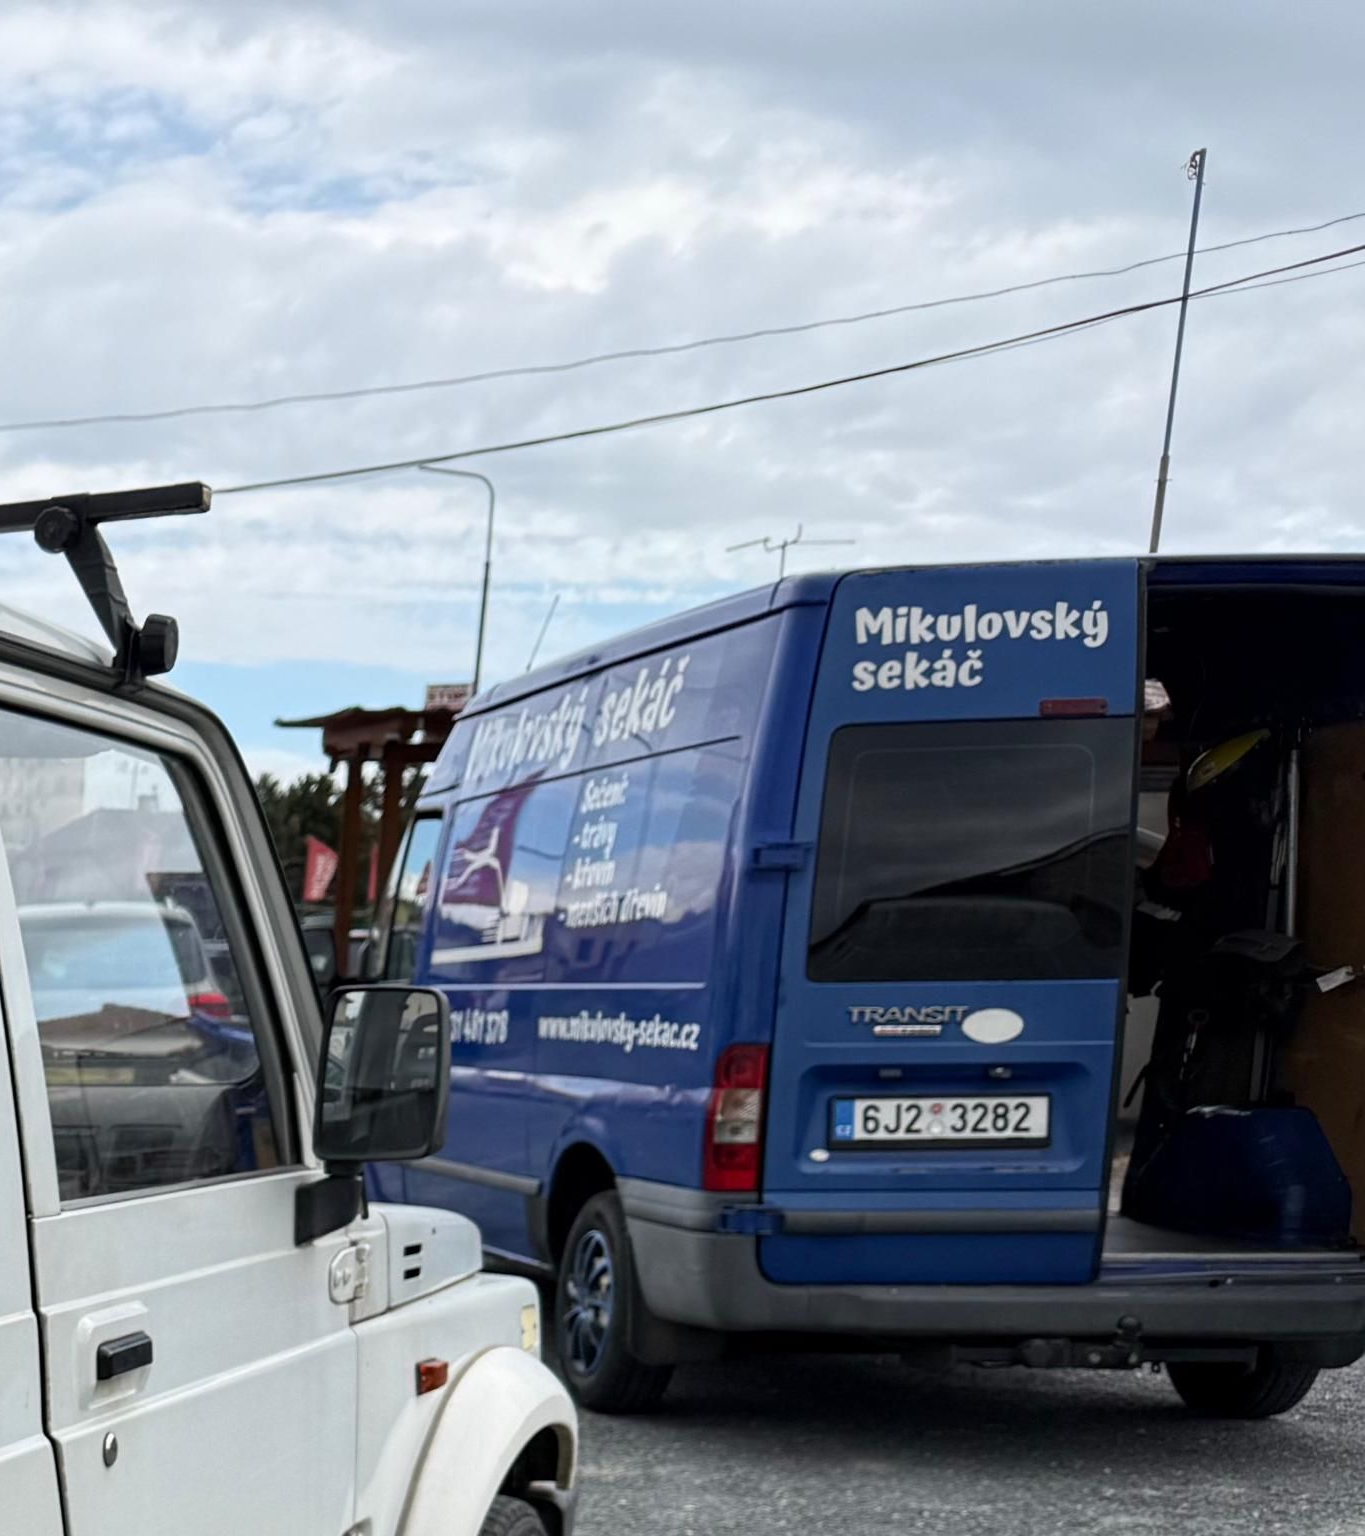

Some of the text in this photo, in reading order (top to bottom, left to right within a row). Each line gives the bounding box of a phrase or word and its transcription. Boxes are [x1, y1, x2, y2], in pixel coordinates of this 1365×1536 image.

[855, 600, 1109, 648] Mikulovský
[851, 649, 983, 692] sekáč
[594, 655, 691, 747] sekáč
[848, 1005, 969, 1024] TRANSIT
[862, 1102, 1031, 1134] 6J2 3282
